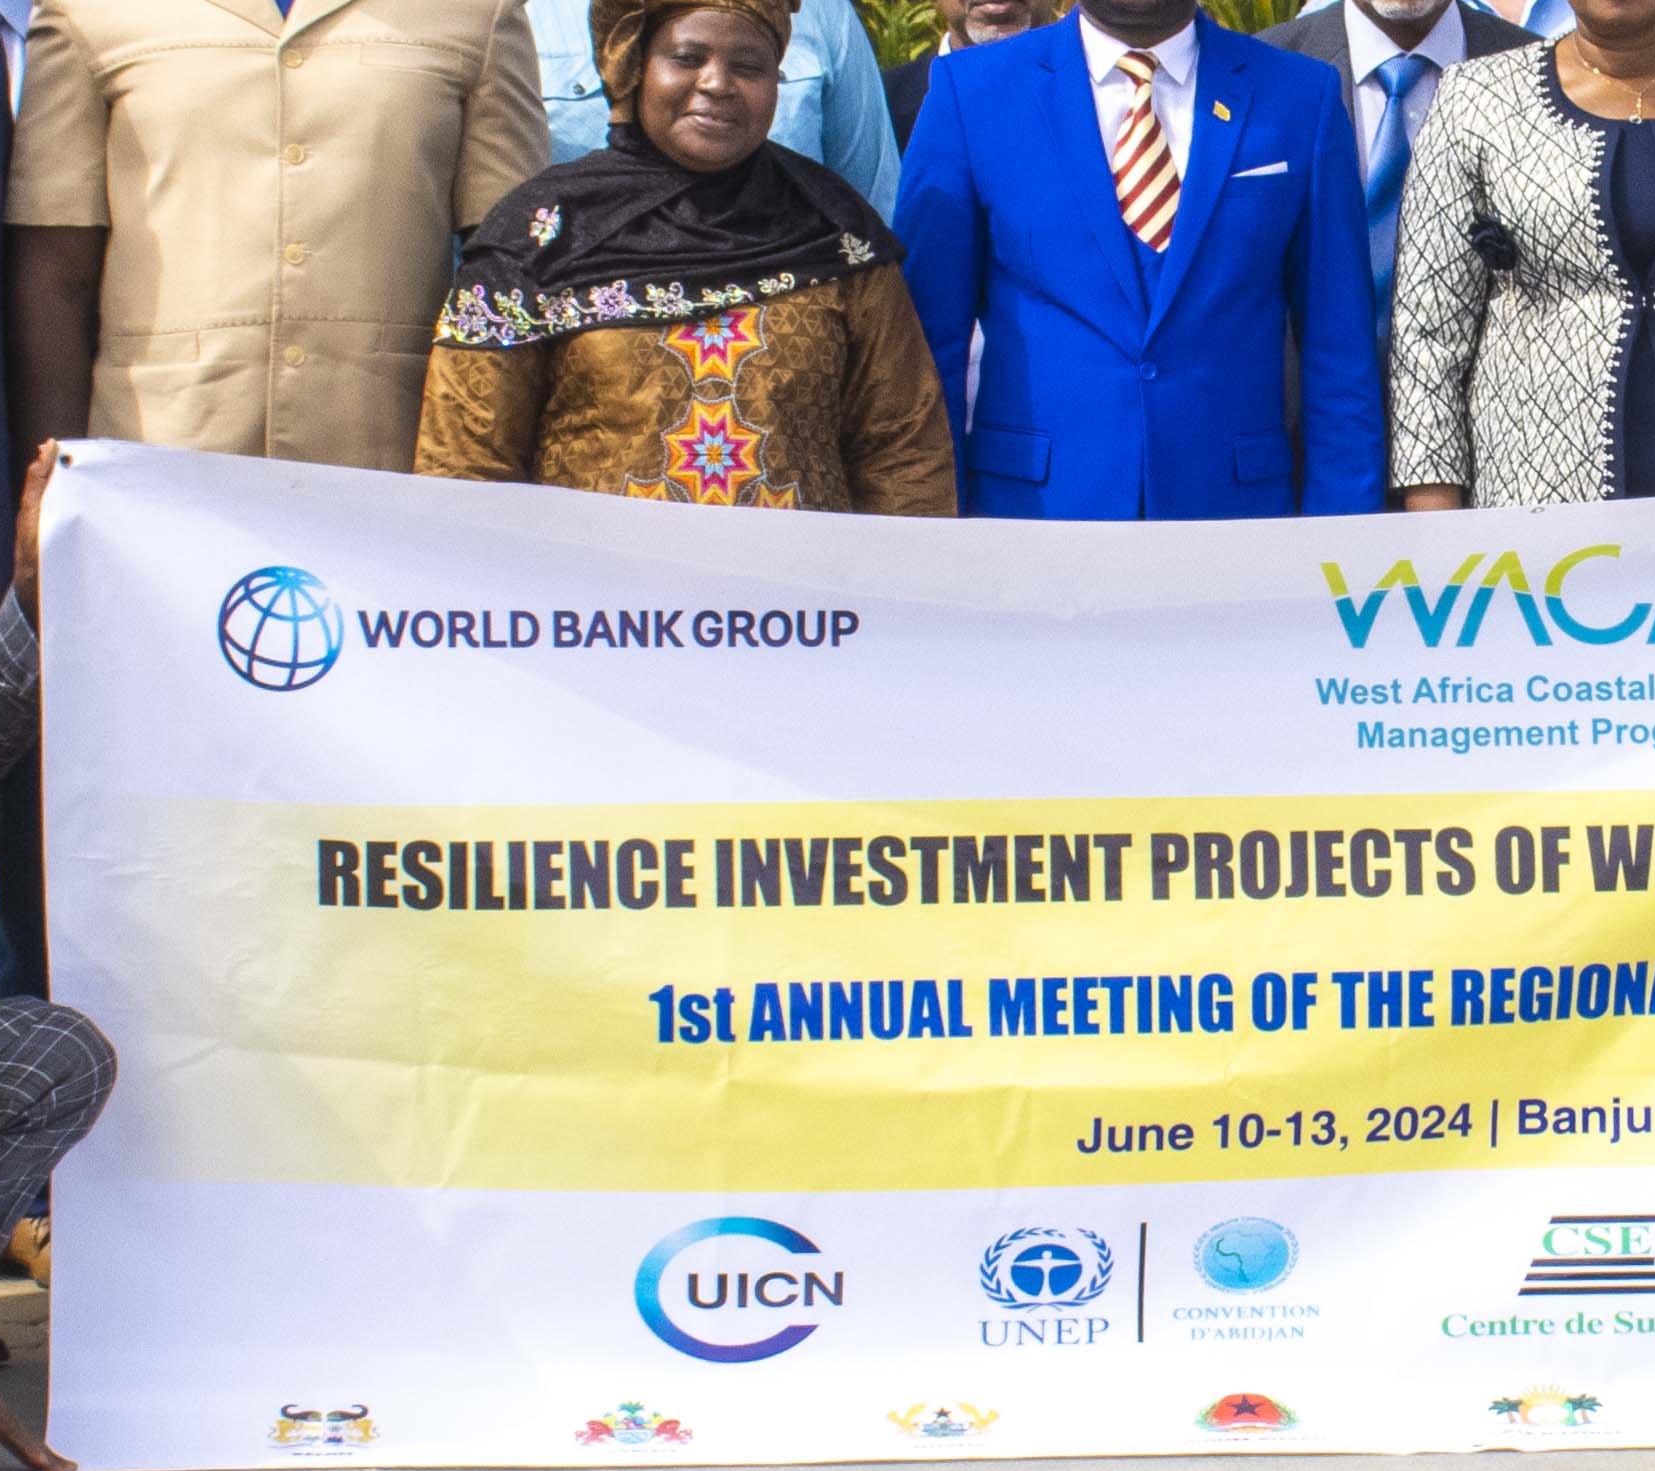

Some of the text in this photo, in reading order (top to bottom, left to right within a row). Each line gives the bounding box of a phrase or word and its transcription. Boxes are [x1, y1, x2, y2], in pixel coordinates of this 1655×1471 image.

[357, 610, 860, 649] WORLD BANK GROUP
[1315, 677, 1402, 705] West
[1411, 676, 1514, 704] Africa
[1526, 673, 1655, 703] Coastal
[1357, 719, 1580, 755] Management
[318, 837, 698, 911] RESILIENCE
[715, 831, 1132, 908] INVESTMENT
[1150, 827, 1476, 901] PROJECTS
[1494, 826, 1571, 895] OF
[648, 985, 737, 1044] 1st
[747, 979, 973, 1043] ANNUAL
[988, 974, 1234, 1038] MEETING
[1251, 972, 1318, 1032] OF
[1331, 971, 1434, 1029] THE
[1076, 1118, 1195, 1154] June
[1211, 1108, 1349, 1152] 10-13,
[1365, 1104, 1473, 1142] 2024
[1542, 1225, 1653, 1258] CSE
[687, 1271, 845, 1309] UICN
[1172, 1303, 1321, 1322] CONVENTION
[1441, 1313, 1556, 1339] Centre
[1564, 1309, 1604, 1335] de
[979, 1317, 1112, 1347] UNEP
[1190, 1325, 1305, 1342] D'ABIDJAN
